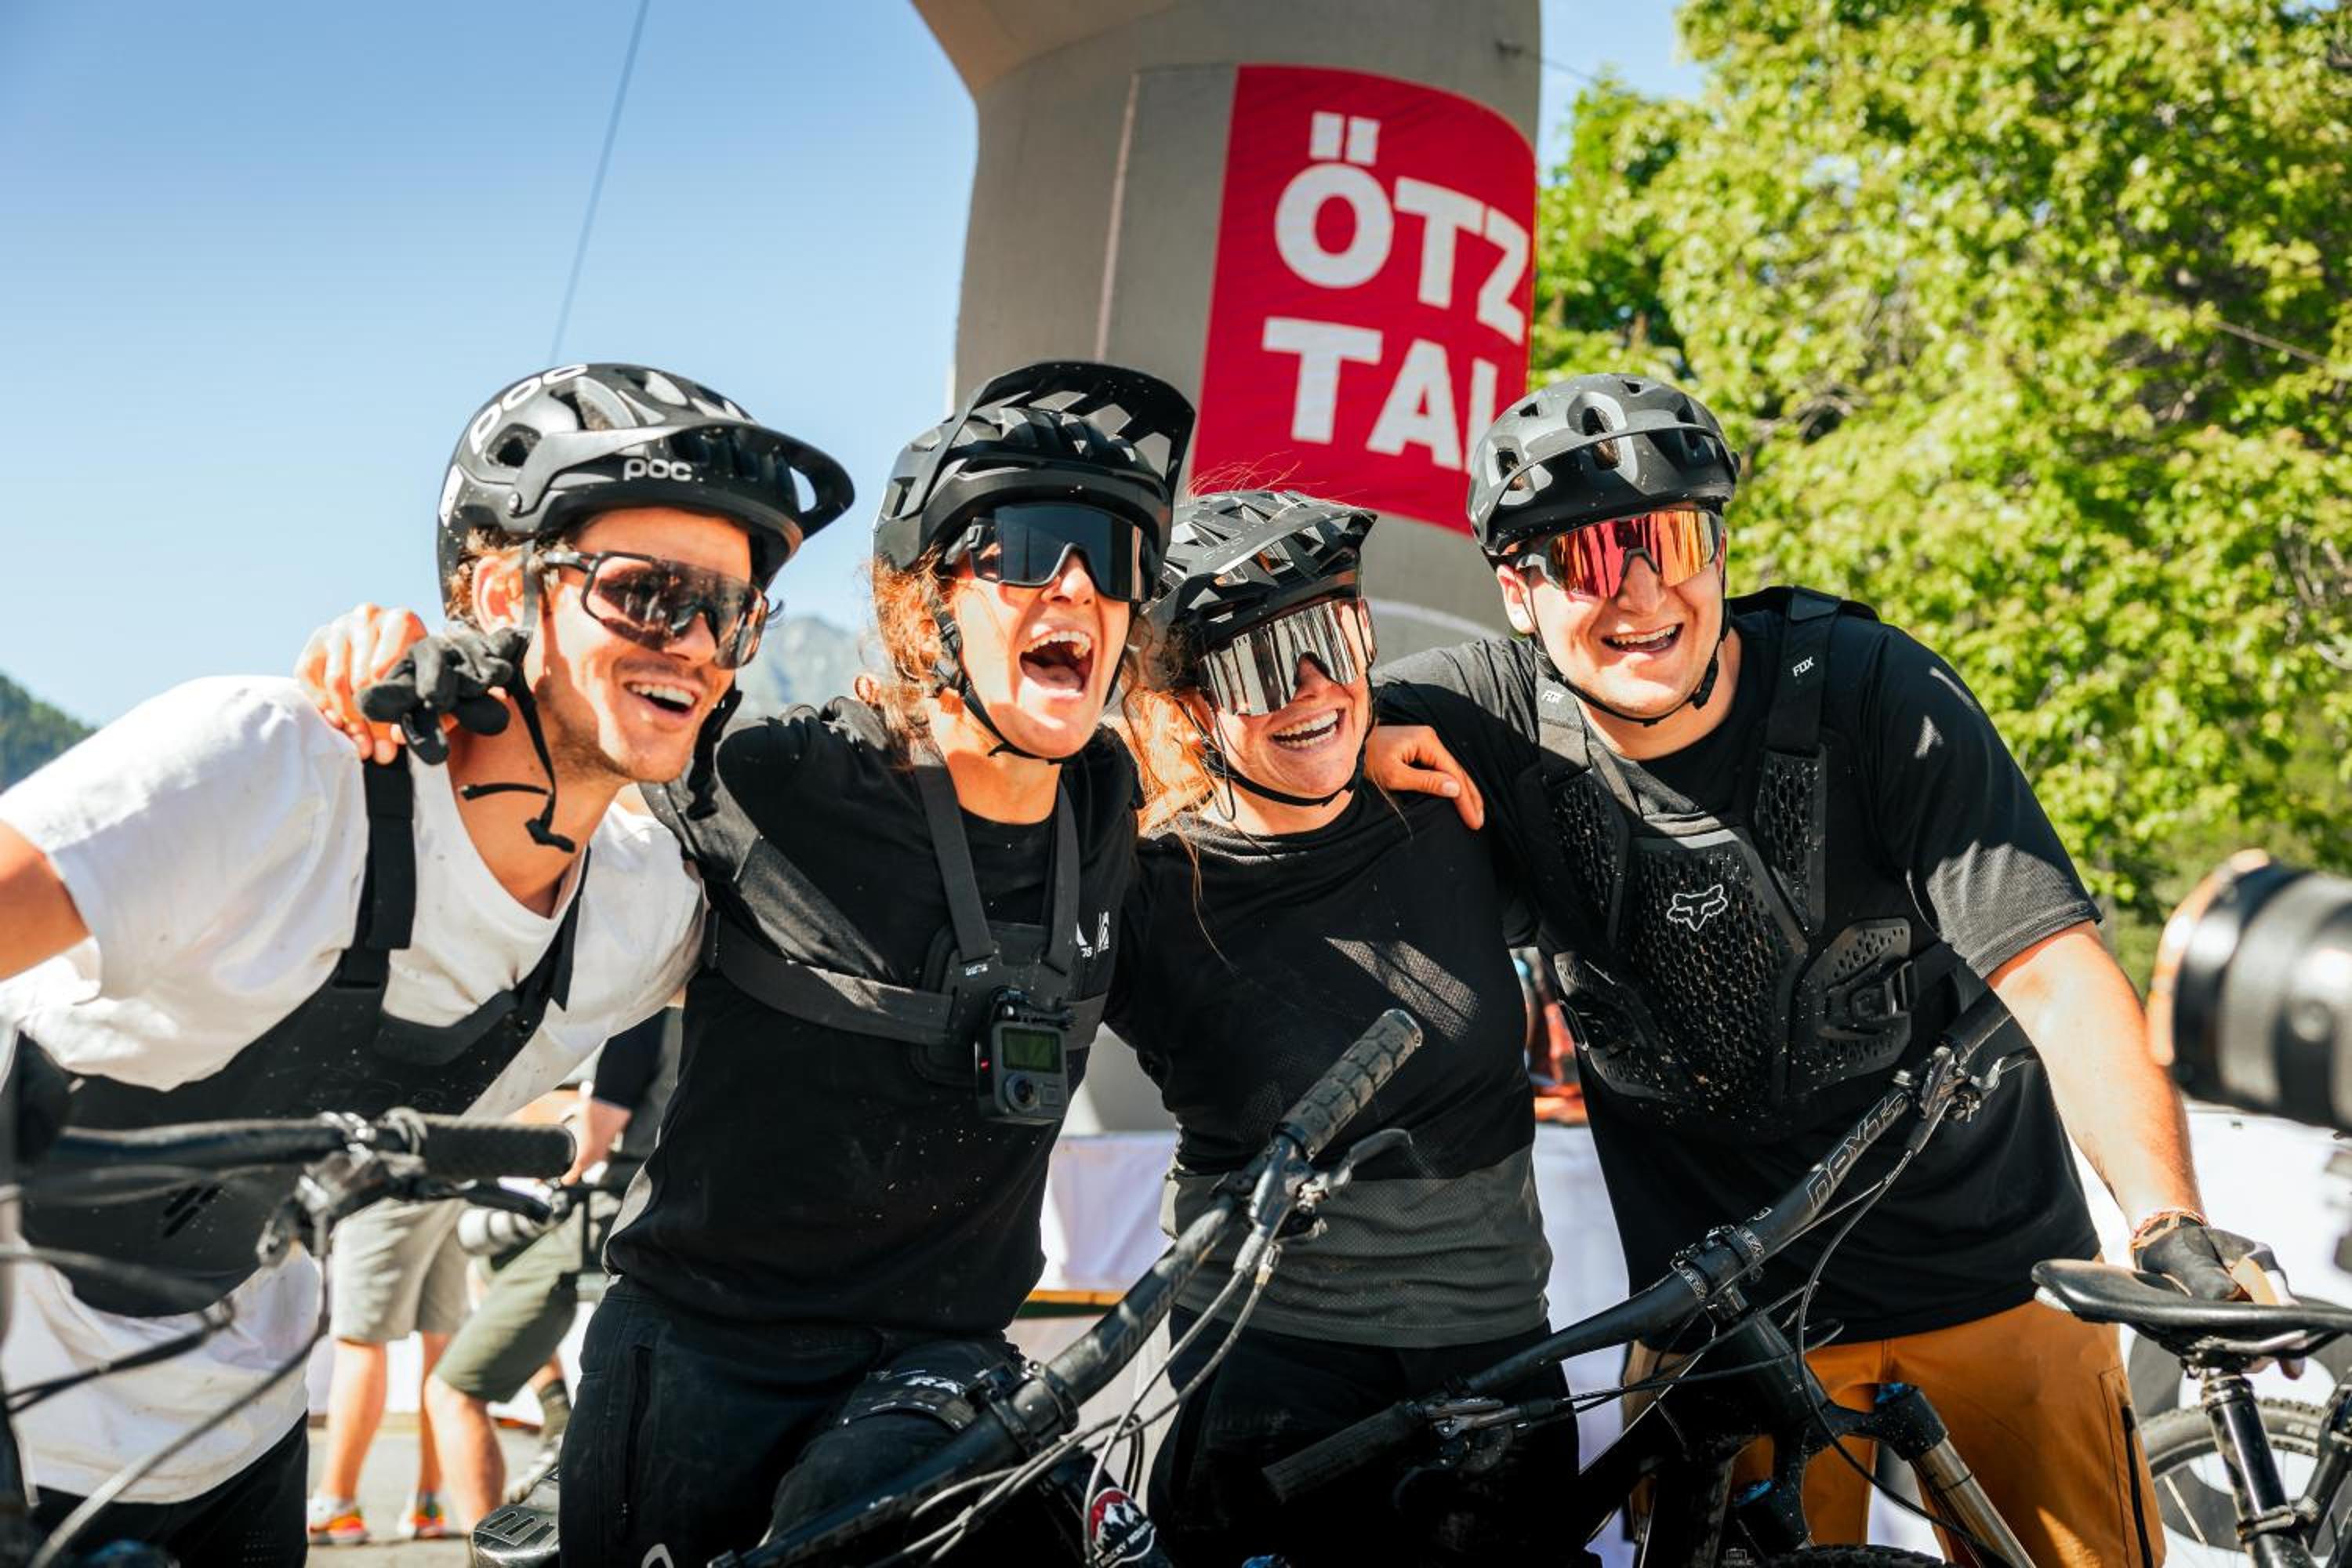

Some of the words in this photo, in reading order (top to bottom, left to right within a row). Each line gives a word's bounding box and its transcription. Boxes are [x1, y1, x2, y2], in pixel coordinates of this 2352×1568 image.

[1273, 111, 1529, 347] ÖTZ
[623, 458, 692, 482] poc
[1793, 656, 1815, 677] FOX
[1541, 690, 1566, 703] FOX
